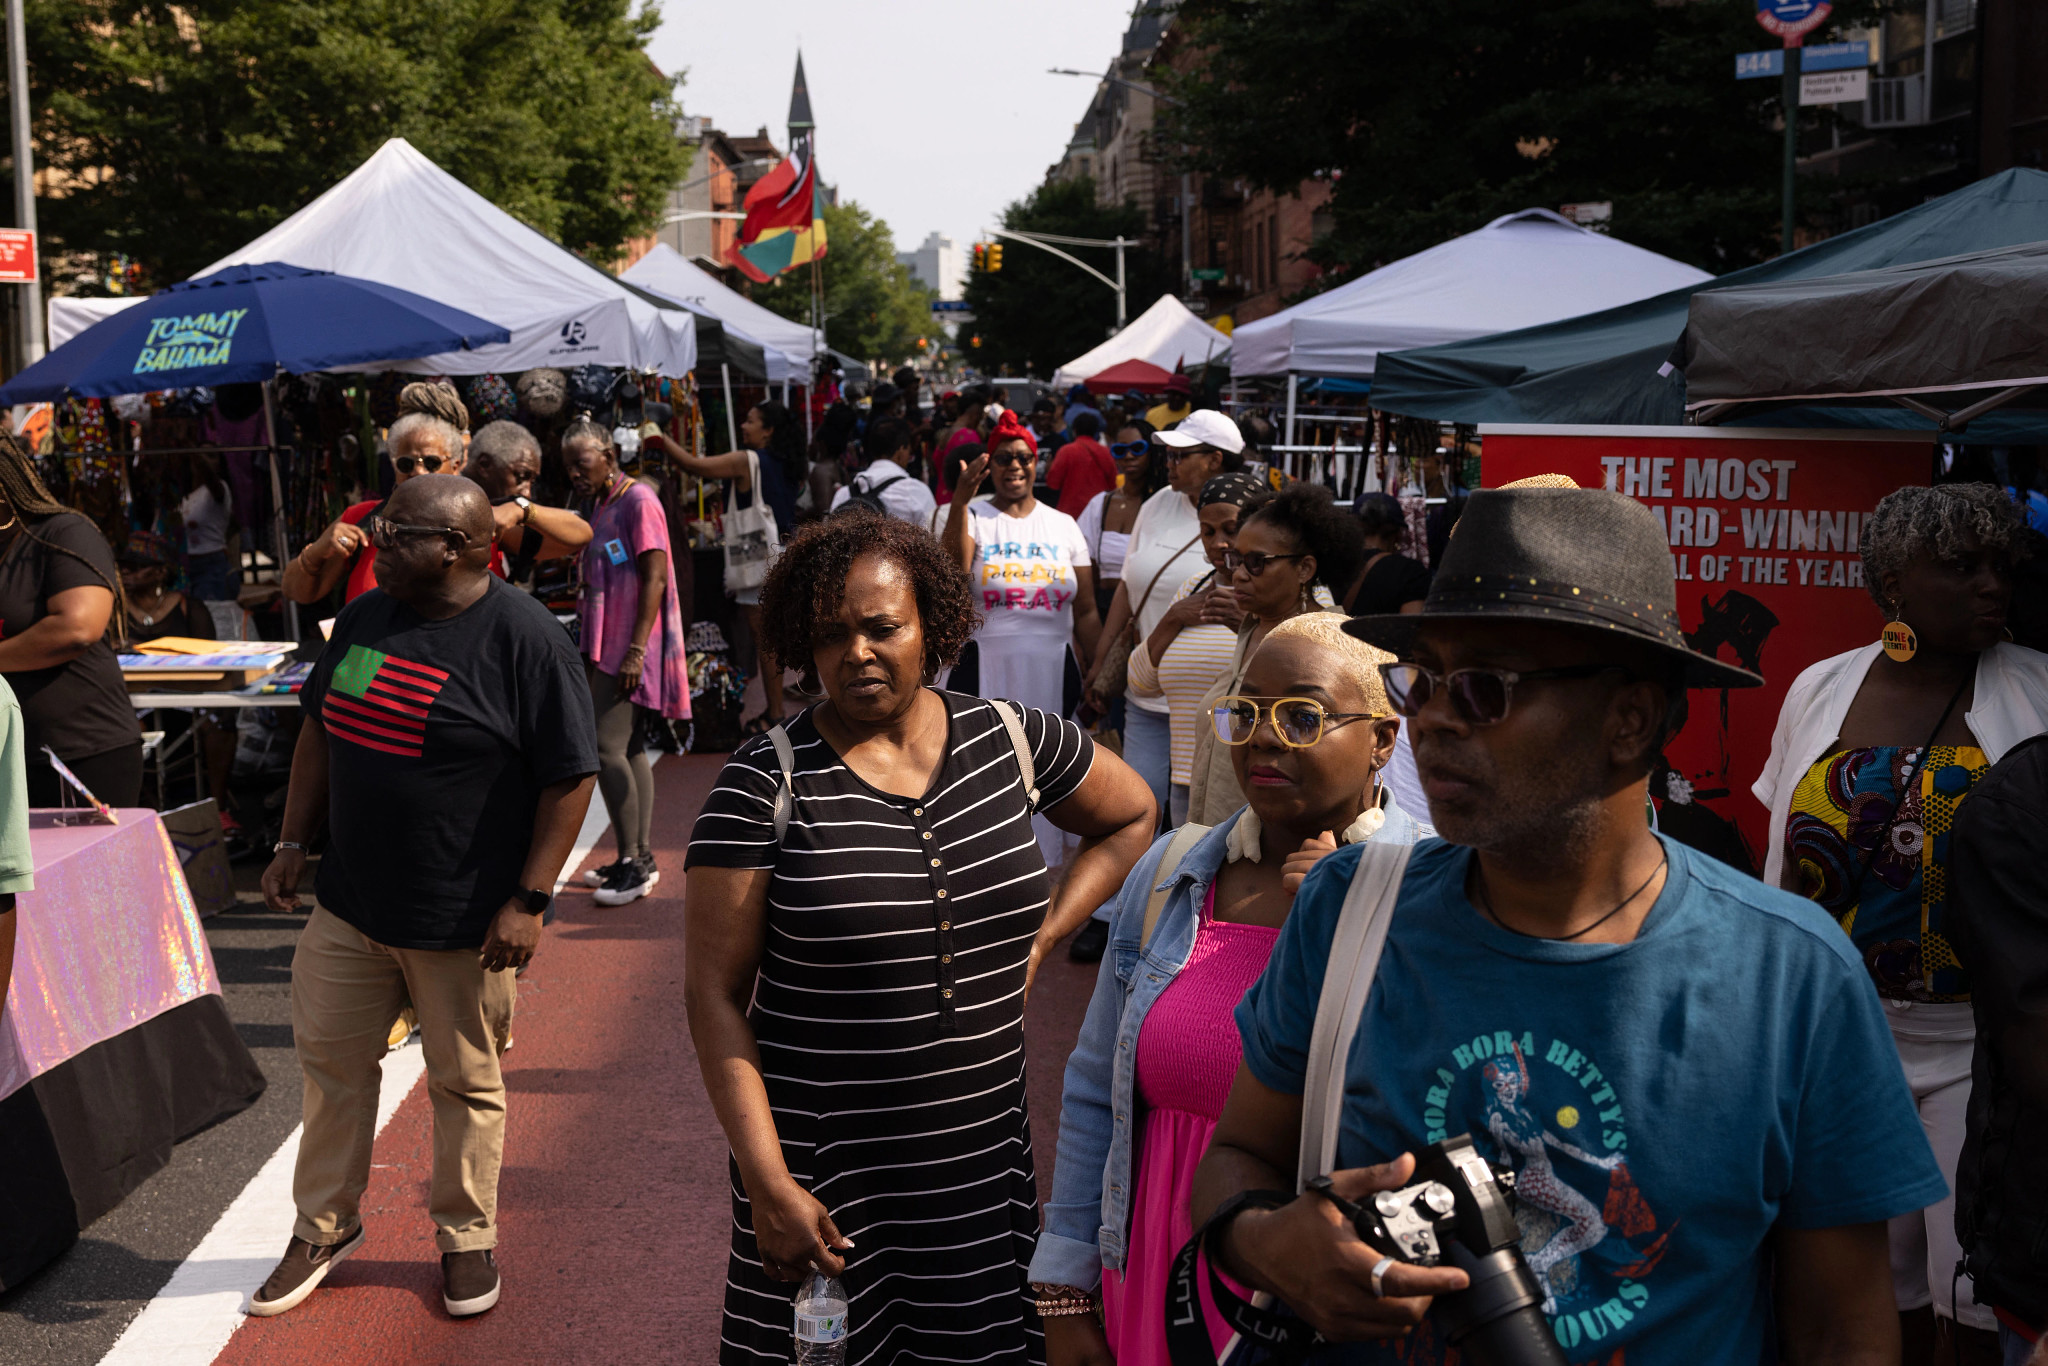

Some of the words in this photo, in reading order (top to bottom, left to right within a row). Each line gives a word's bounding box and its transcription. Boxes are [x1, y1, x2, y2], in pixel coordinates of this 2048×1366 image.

[1736, 52, 1771, 74] B44
[145, 307, 249, 346] TOMMY
[132, 338, 233, 375] BAHAMA
[1600, 456, 1675, 498] THE
[1682, 458, 1797, 501] MOST
[983, 541, 1060, 562] PRAY
[982, 563, 1067, 586] PRAY
[991, 570, 1033, 579] over
[1699, 554, 1733, 583] OF
[1738, 555, 1790, 585] THE
[1795, 558, 1865, 588] YEAR
[982, 587, 1072, 612] PRAY
[1883, 630, 1907, 643] JUNE
[1884, 642, 1907, 651] TEENTH
[1423, 1068, 1456, 1146] BORA
[1452, 1030, 1535, 1071] BORA
[1173, 1244, 1196, 1327] LUMI
[1546, 1278, 1650, 1349] OURS
